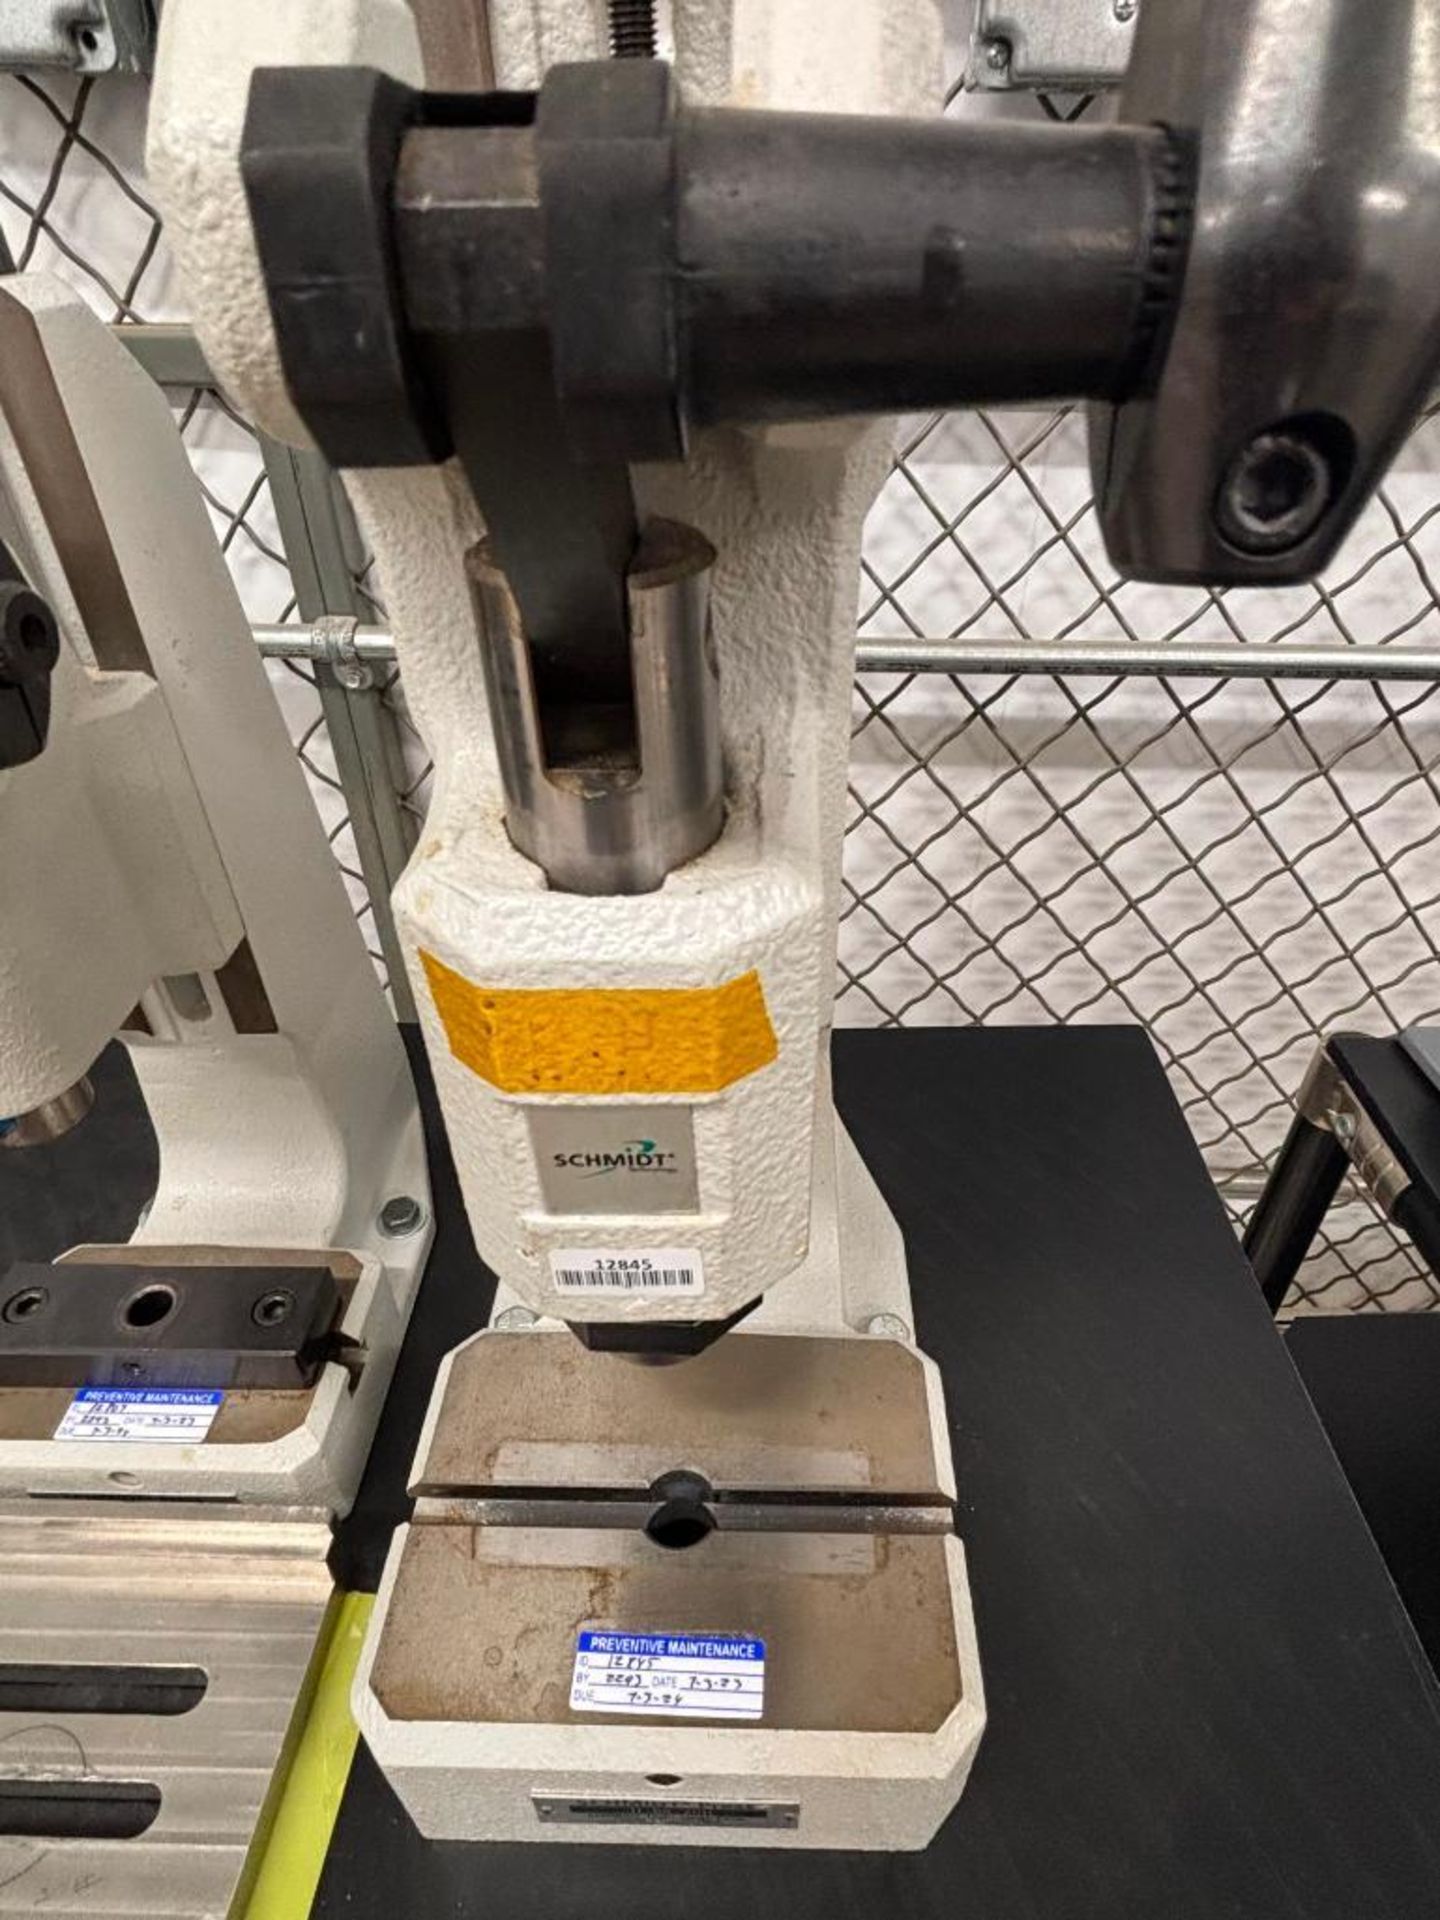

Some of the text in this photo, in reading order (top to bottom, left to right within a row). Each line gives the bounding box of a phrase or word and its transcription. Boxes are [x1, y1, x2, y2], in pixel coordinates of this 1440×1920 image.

[595, 1258, 653, 1271] 12845
[83, 1391, 215, 1404] PREVENTIVE MAINTENANCE
[590, 1637, 756, 1658] PREVENTIVE MAINTENANCE
[576, 1672, 590, 1684] BY
[652, 1675, 678, 1689] DATE
